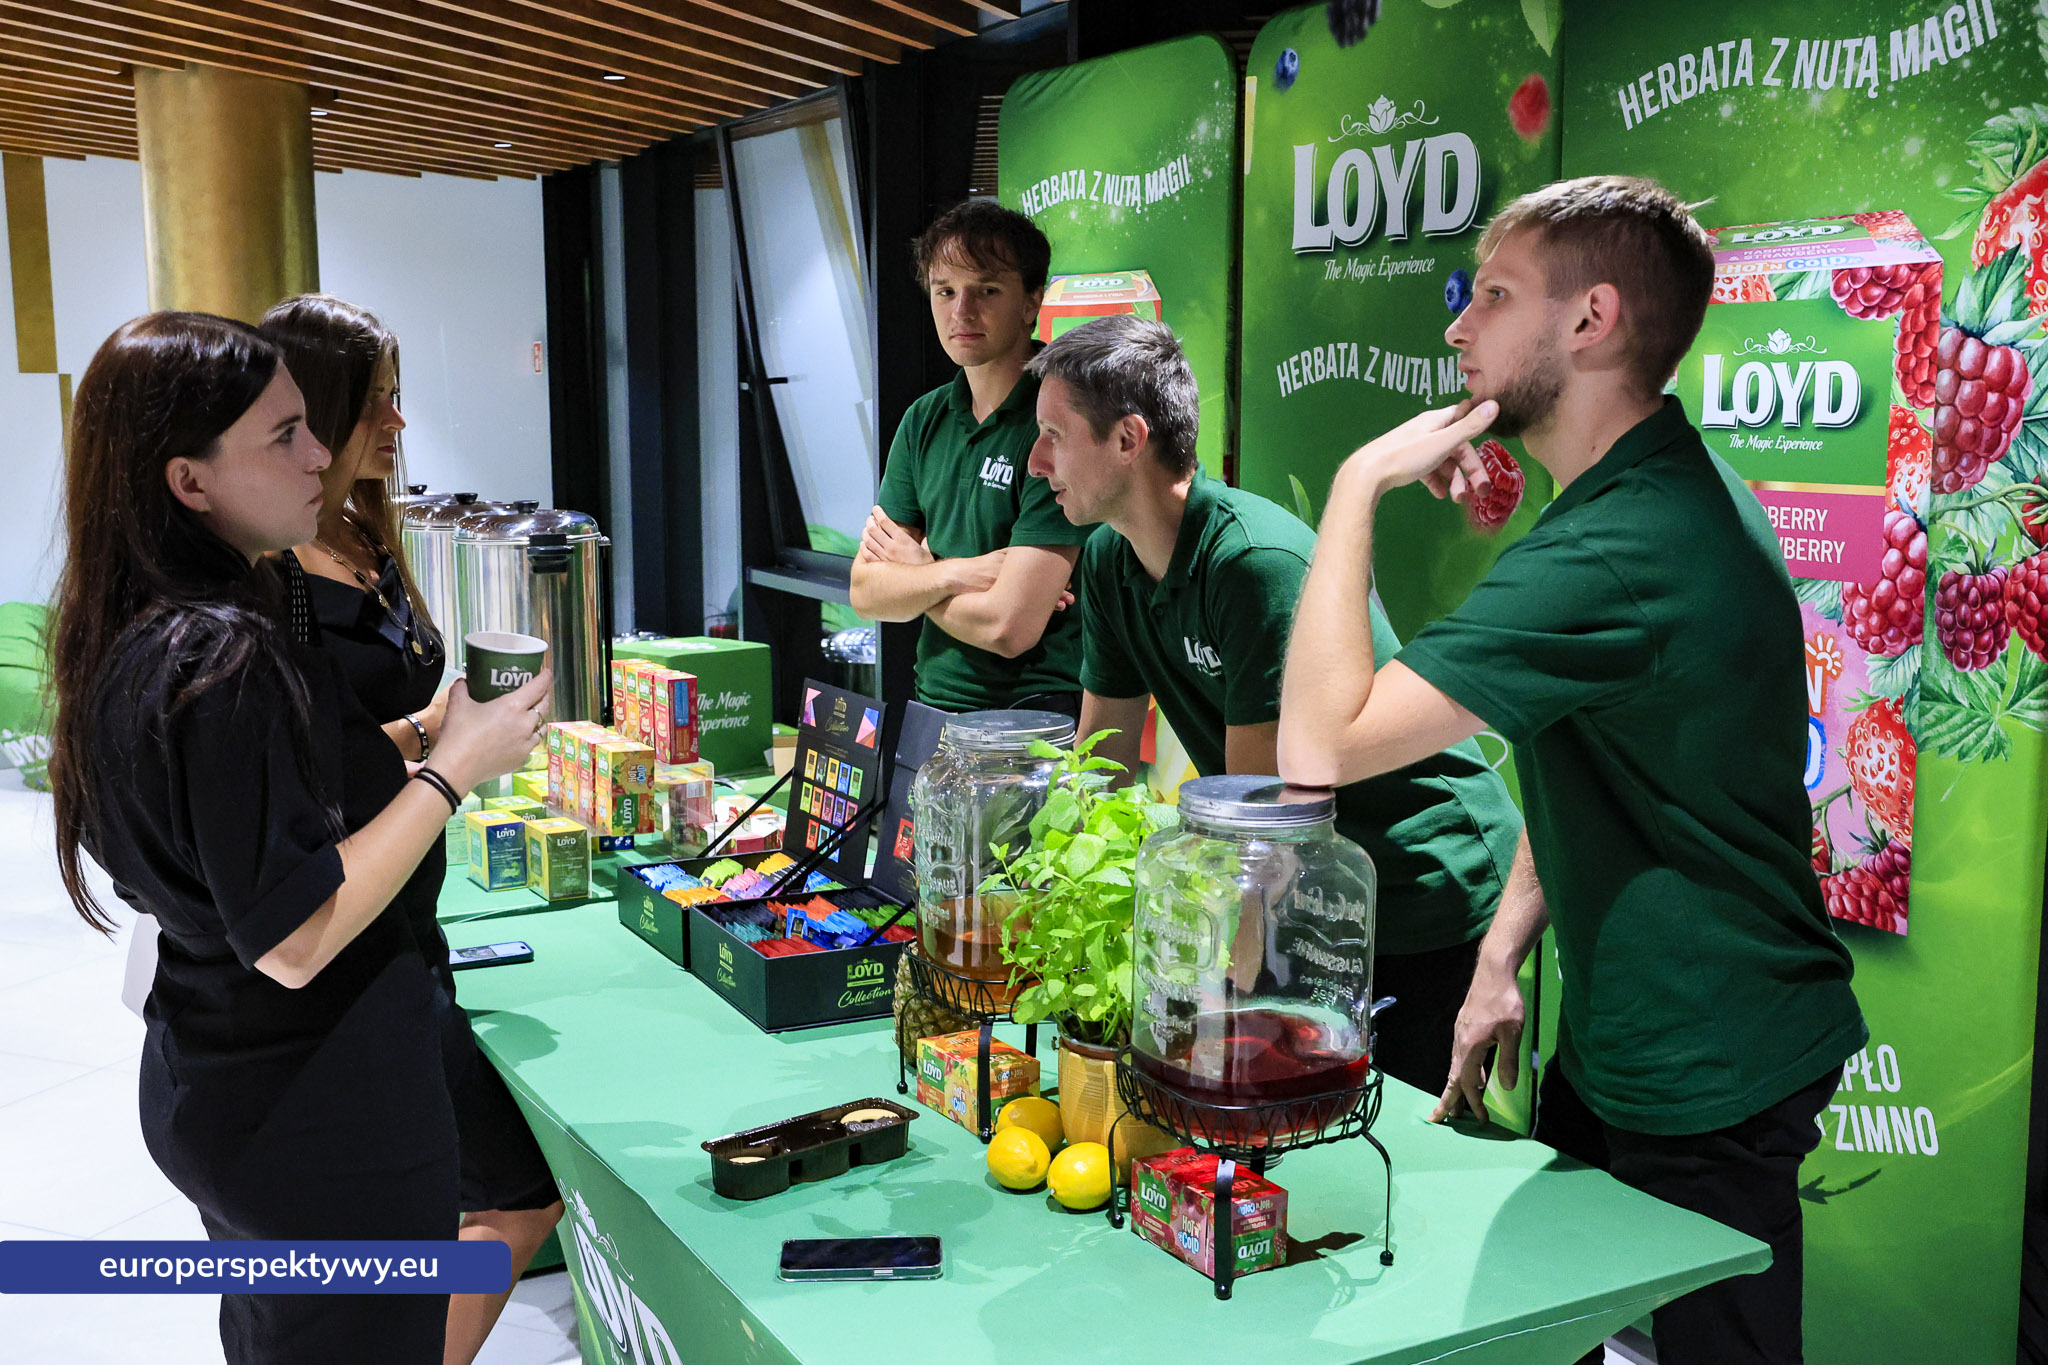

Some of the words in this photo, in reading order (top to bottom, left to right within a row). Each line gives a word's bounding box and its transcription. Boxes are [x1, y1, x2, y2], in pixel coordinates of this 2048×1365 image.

[1618, 38, 1753, 131] HERBATA
[1763, 37, 1790, 87] Z
[1792, 35, 1879, 99] NUTĄ
[1890, 0, 1998, 82] MAGII
[1022, 169, 1086, 217] HERBATA
[1089, 170, 1102, 202] Z
[1102, 173, 1141, 214] NUTĄ
[1145, 153, 1191, 205] MAGII
[1292, 132, 1481, 255] LOYD
[1731, 225, 1846, 244] LOYD
[1324, 259, 1343, 281] The
[1342, 258, 1377, 285] Magic
[1377, 255, 1436, 282] Experience
[1276, 342, 1359, 398] HERBATA
[1363, 345, 1380, 384] Z
[1381, 352, 1433, 406] NUTĄ
[1437, 354, 1469, 396] MA
[1701, 353, 1862, 430] LOYD
[1729, 433, 1745, 449] The
[1745, 434, 1775, 454] Magic
[1774, 434, 1824, 454] Experience
[979, 456, 1014, 486] LOYD
[1763, 505, 1829, 532] BERRY
[1780, 536, 1846, 564] BERRY
[715, 690, 751, 711] Magic
[622, 798, 632, 825] LOYD
[496, 829, 516, 839] LOYD
[556, 838, 577, 847] LOYD
[846, 962, 884, 980] LOYD
[837, 986, 893, 1009] Collection
[923, 1059, 942, 1081] LOYD
[1837, 1044, 1901, 1093] PŁO
[1829, 1104, 1939, 1156] ZIMNO
[1140, 1182, 1167, 1209] LOYD
[1237, 1239, 1271, 1260] LOYD
